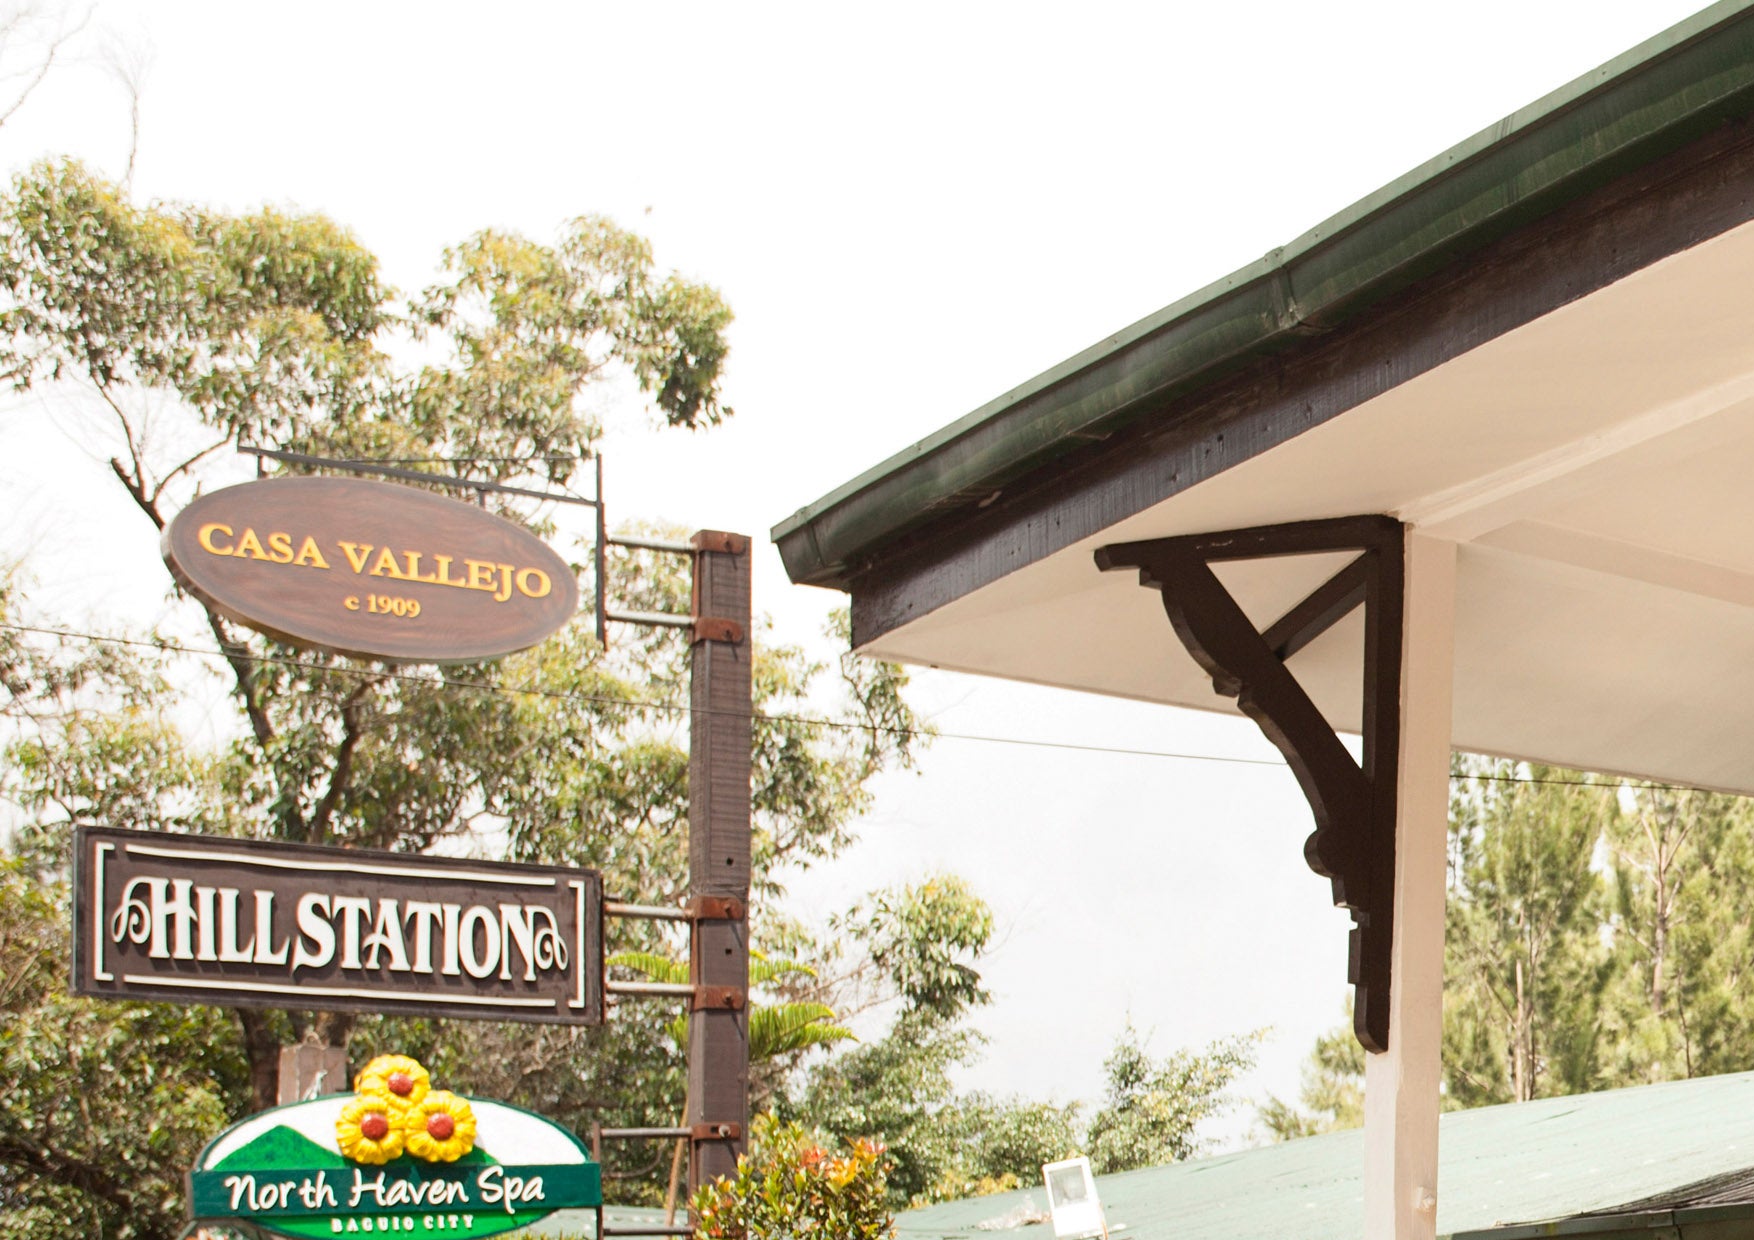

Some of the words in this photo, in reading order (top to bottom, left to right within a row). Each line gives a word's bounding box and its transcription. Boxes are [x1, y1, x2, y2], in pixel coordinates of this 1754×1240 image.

[197, 522, 330, 569] CASA
[337, 540, 552, 602] VALLEJO
[344, 595, 360, 611] c
[367, 594, 421, 618] 1909
[111, 875, 291, 965] HILL
[291, 892, 569, 981] STATION
[224, 1169, 338, 1211] North
[349, 1168, 469, 1208] Haven
[477, 1165, 546, 1214] Spa
[331, 1215, 415, 1233] BAGUIO
[423, 1214, 476, 1231] CITY
